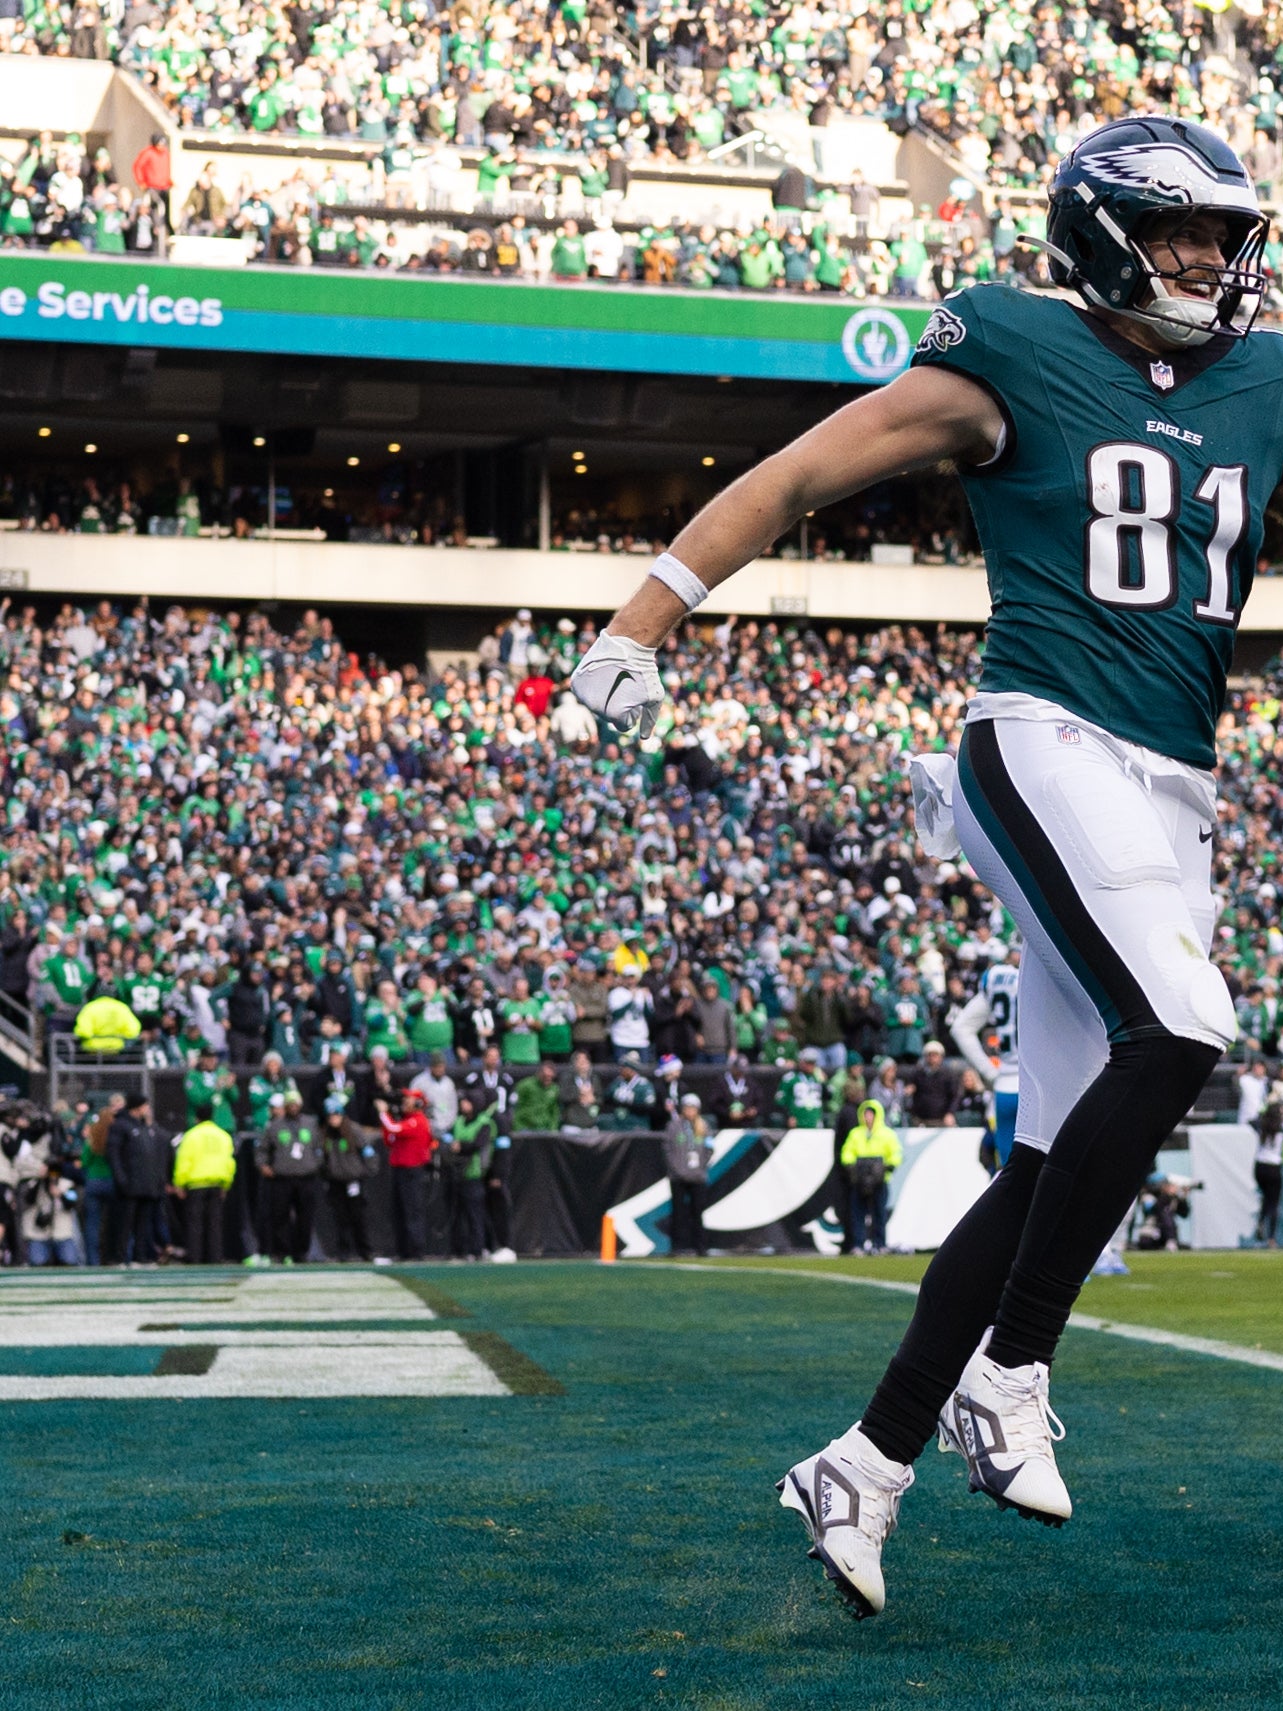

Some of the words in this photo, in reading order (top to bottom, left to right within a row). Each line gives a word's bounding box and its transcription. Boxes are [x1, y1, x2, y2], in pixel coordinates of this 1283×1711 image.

[0, 286, 27, 316] e
[37, 281, 223, 327] Services
[1145, 420, 1204, 446] EAGLES
[1086, 441, 1247, 626] 81
[822, 1480, 833, 1521] ALPHA
